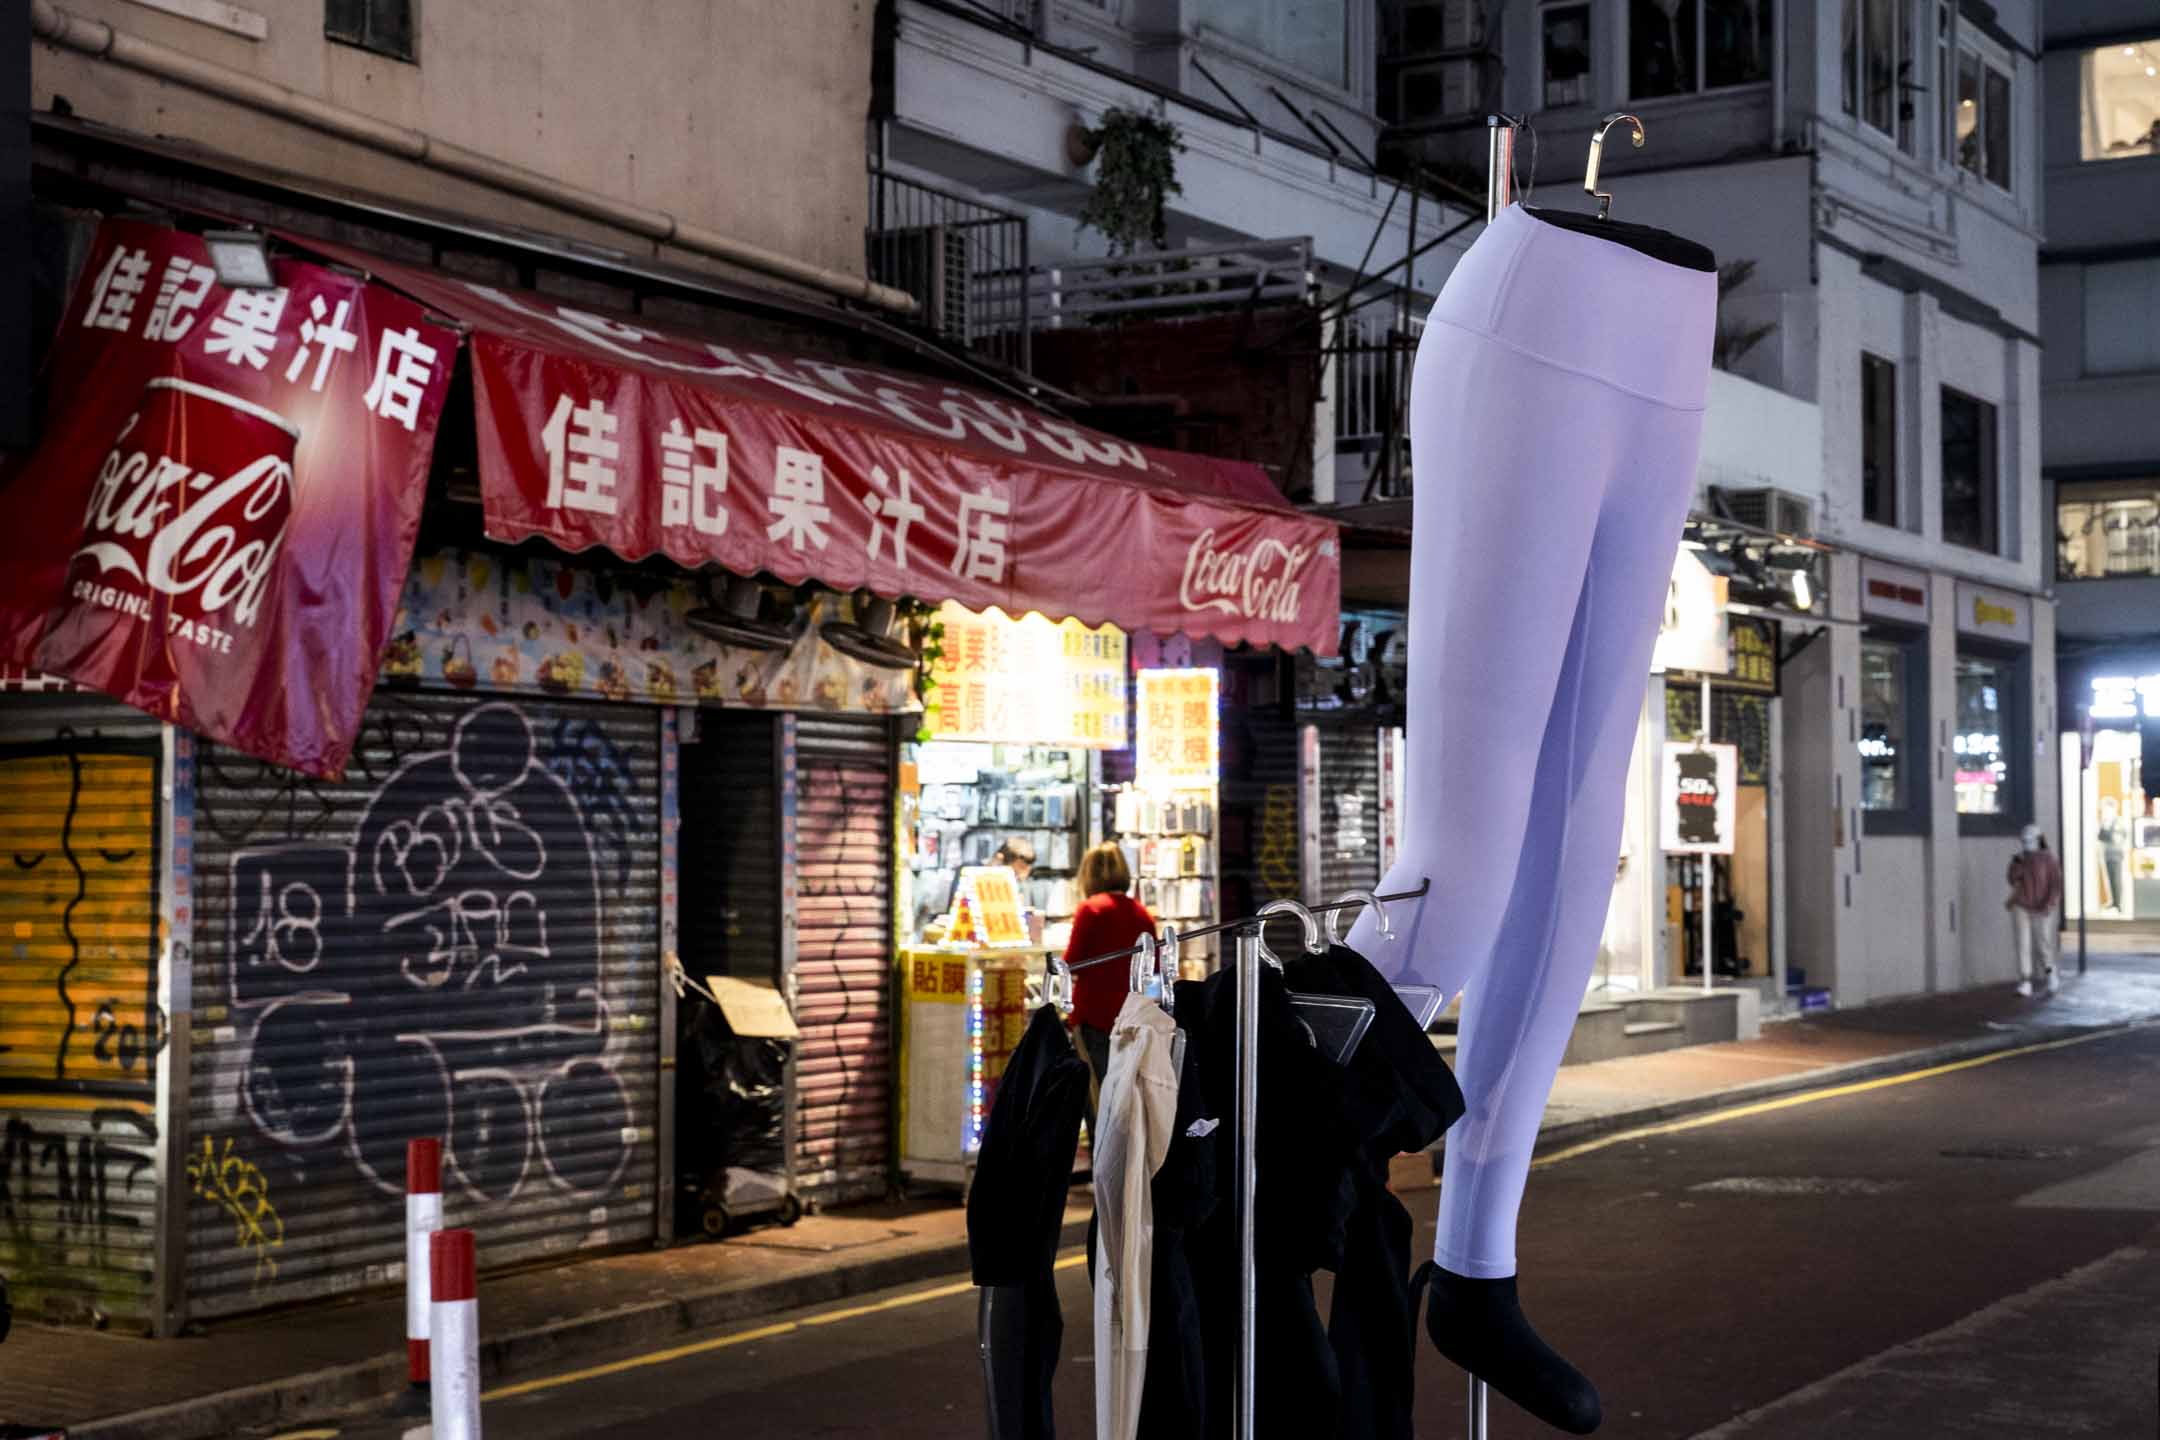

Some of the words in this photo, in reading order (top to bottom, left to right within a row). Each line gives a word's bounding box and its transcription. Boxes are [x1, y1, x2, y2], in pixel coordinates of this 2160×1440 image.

[82, 244, 438, 431] 佳記果汁店
[541, 393, 1010, 583] 佳記果汁店
[167, 612, 234, 655] TASTE
